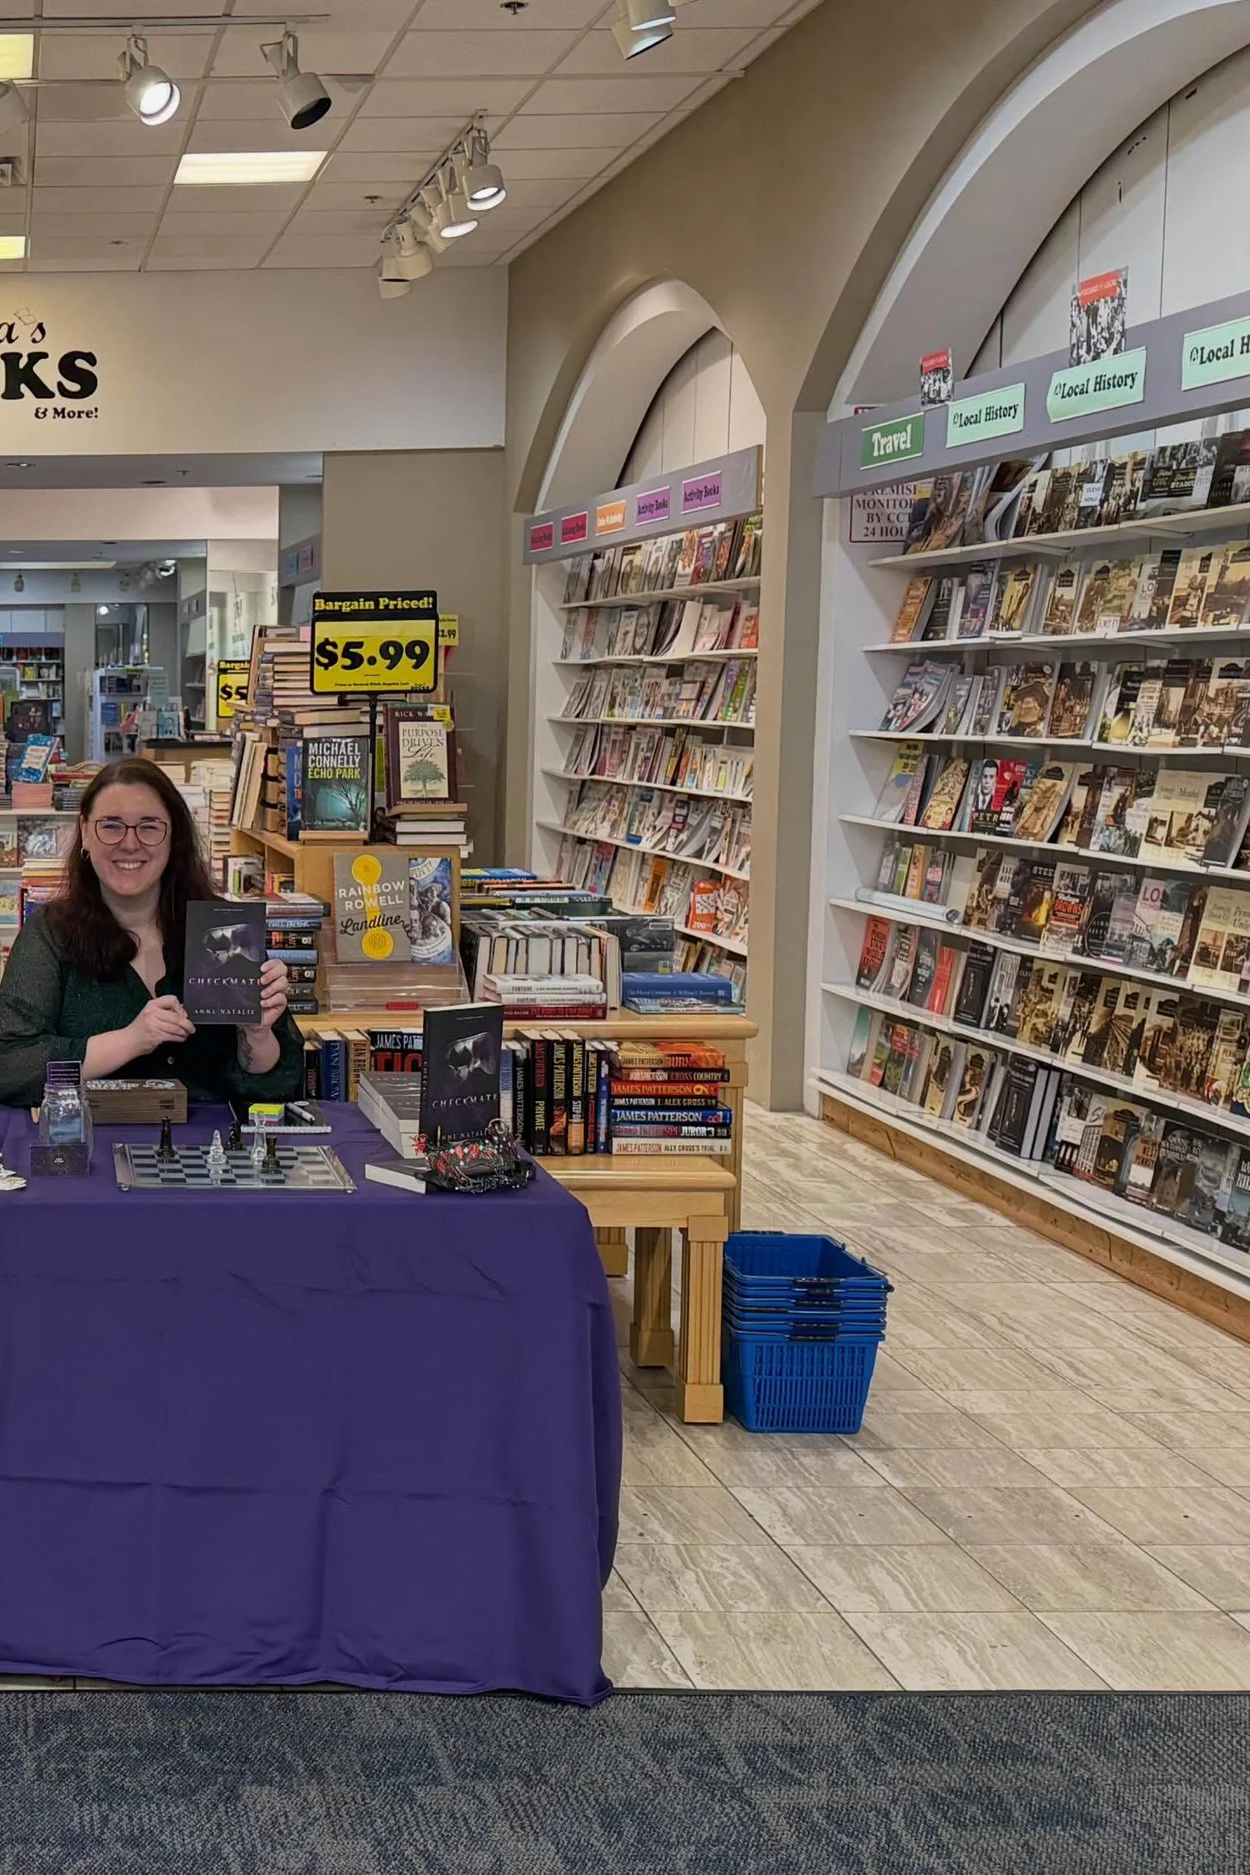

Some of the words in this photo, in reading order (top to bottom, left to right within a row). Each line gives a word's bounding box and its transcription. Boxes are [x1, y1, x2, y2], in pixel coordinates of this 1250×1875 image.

[1199, 339, 1234, 365] Local
[1061, 378, 1090, 399] Local
[1093, 371, 1138, 393] History
[34, 407, 48, 420] &
[52, 407, 99, 419] More!
[958, 409, 981, 428] Local
[984, 403, 1019, 421] History
[872, 424, 911, 457] Travel
[867, 512, 881, 523] BY
[863, 526, 877, 537] 24
[314, 598, 375, 613] Bargain
[378, 596, 433, 610] Priced!
[315, 637, 430, 671] $5.99
[402, 729, 444, 737] PURPOSE
[309, 743, 361, 755] MICHAEL
[402, 738, 444, 747] DRIVEN
[308, 755, 361, 768] CONNELLY
[308, 768, 333, 779] ECHO
[336, 767, 361, 779] PARK
[339, 880, 405, 898] RAINBOW
[345, 895, 403, 911] ROWELL
[340, 914, 404, 936] Landline
[375, 1034, 401, 1049] JAMES
[613, 1085, 641, 1094] JAMES
[642, 1085, 692, 1094] PATTERSON
[432, 1093, 498, 1109] CHECKMATE
[616, 1111, 646, 1121] JAMES
[648, 1111, 702, 1121] PATTERSON
